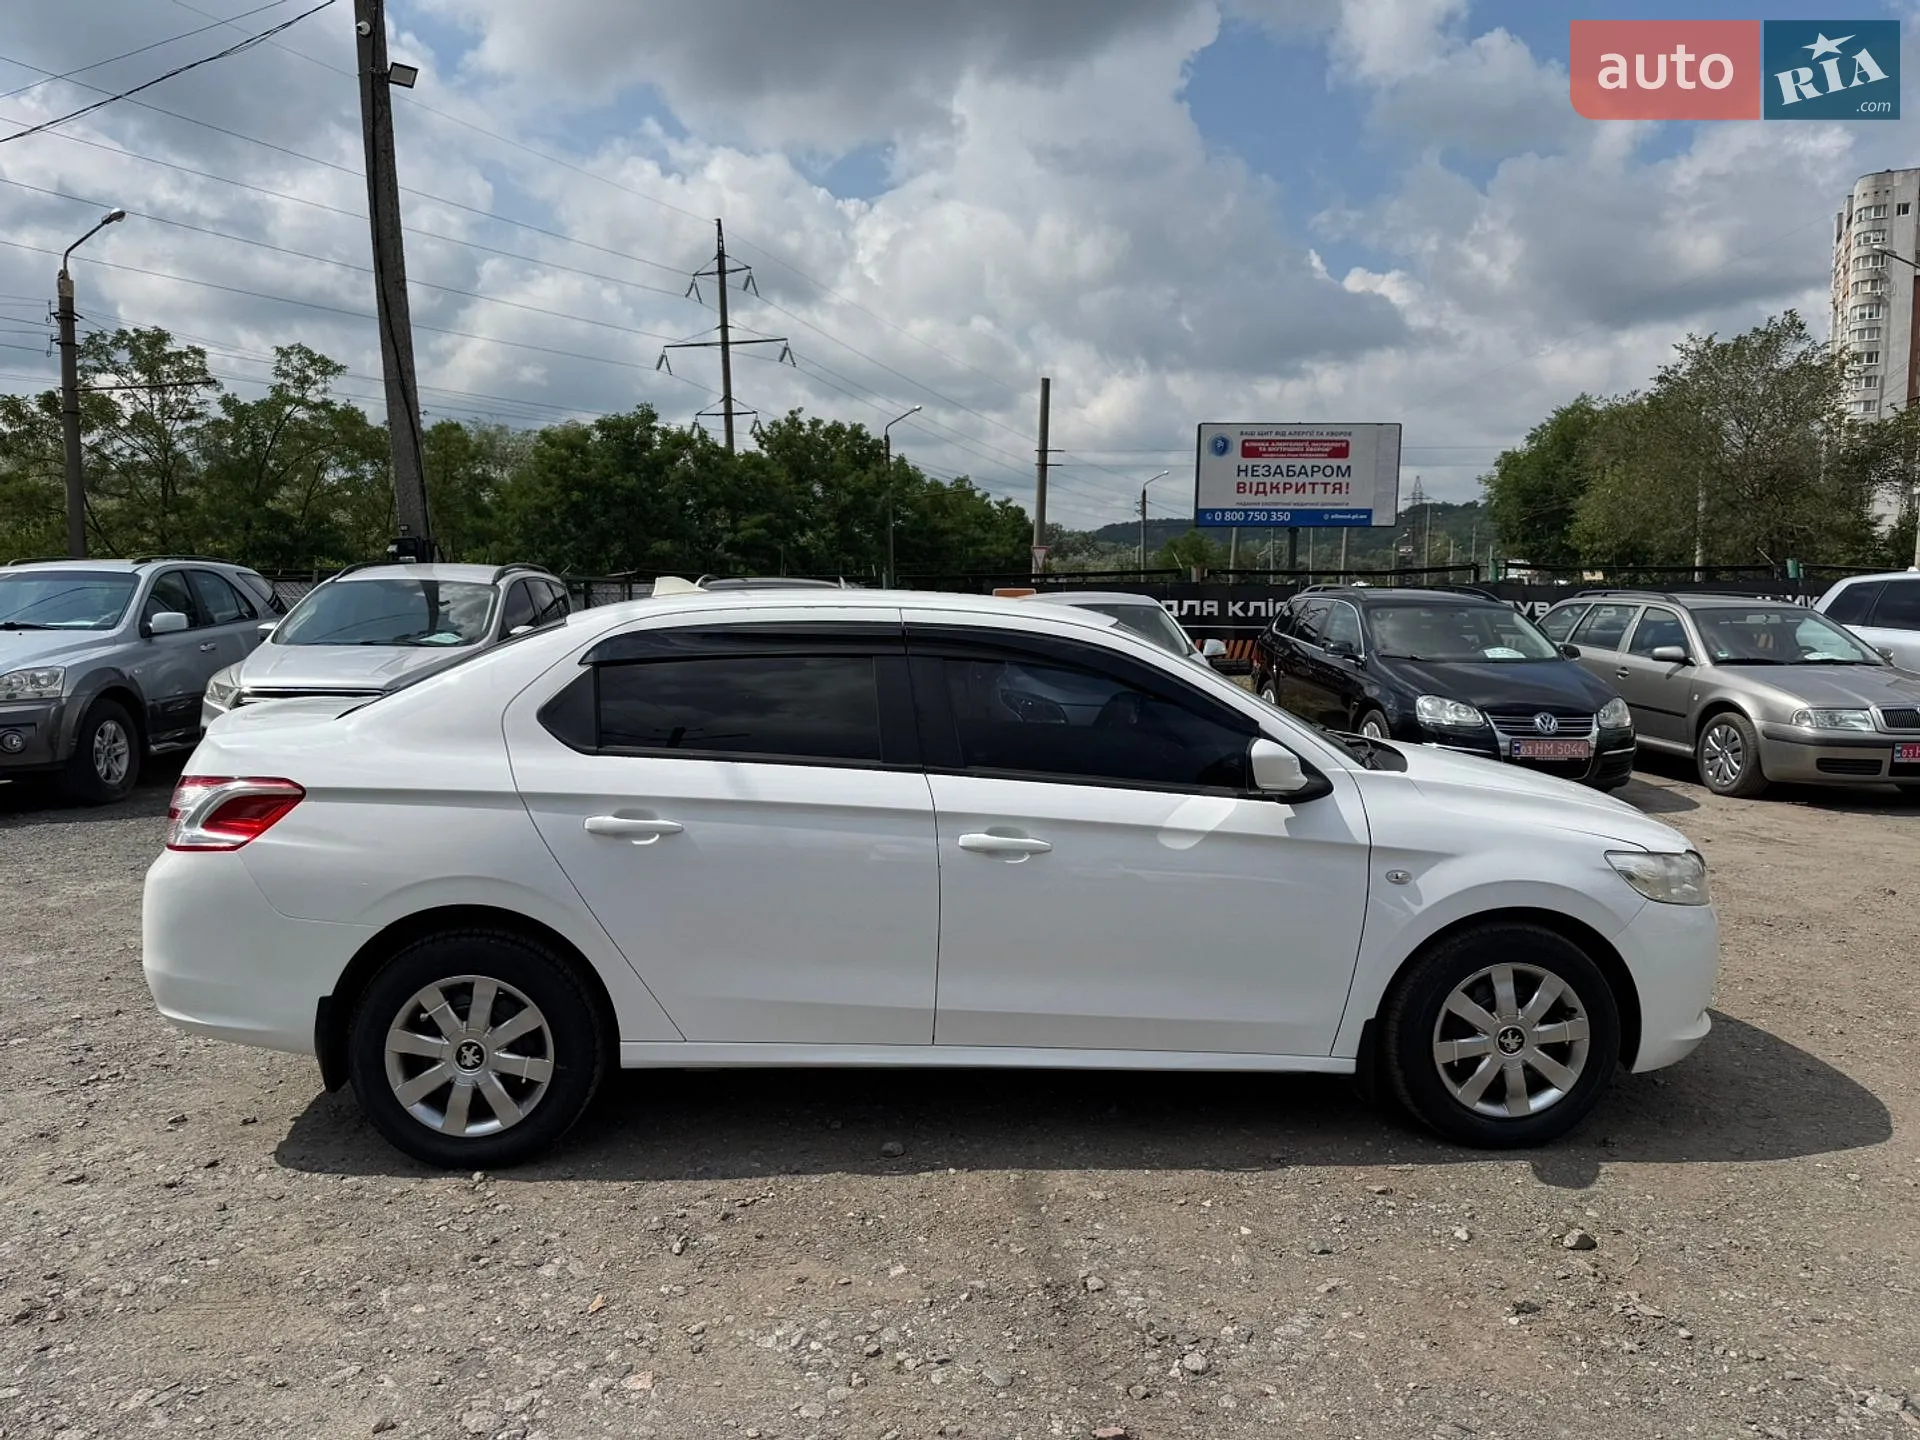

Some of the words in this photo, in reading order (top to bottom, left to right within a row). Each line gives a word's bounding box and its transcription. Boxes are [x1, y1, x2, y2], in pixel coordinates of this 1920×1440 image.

[1236, 464, 1352, 478] НЕЗАБАРОМ
[1236, 481, 1351, 496] ВІДКРИТТЯ!
[1214, 511, 1222, 521] 0
[1224, 511, 1244, 521] 800
[1247, 511, 1268, 521] 750
[1270, 511, 1291, 521] 350
